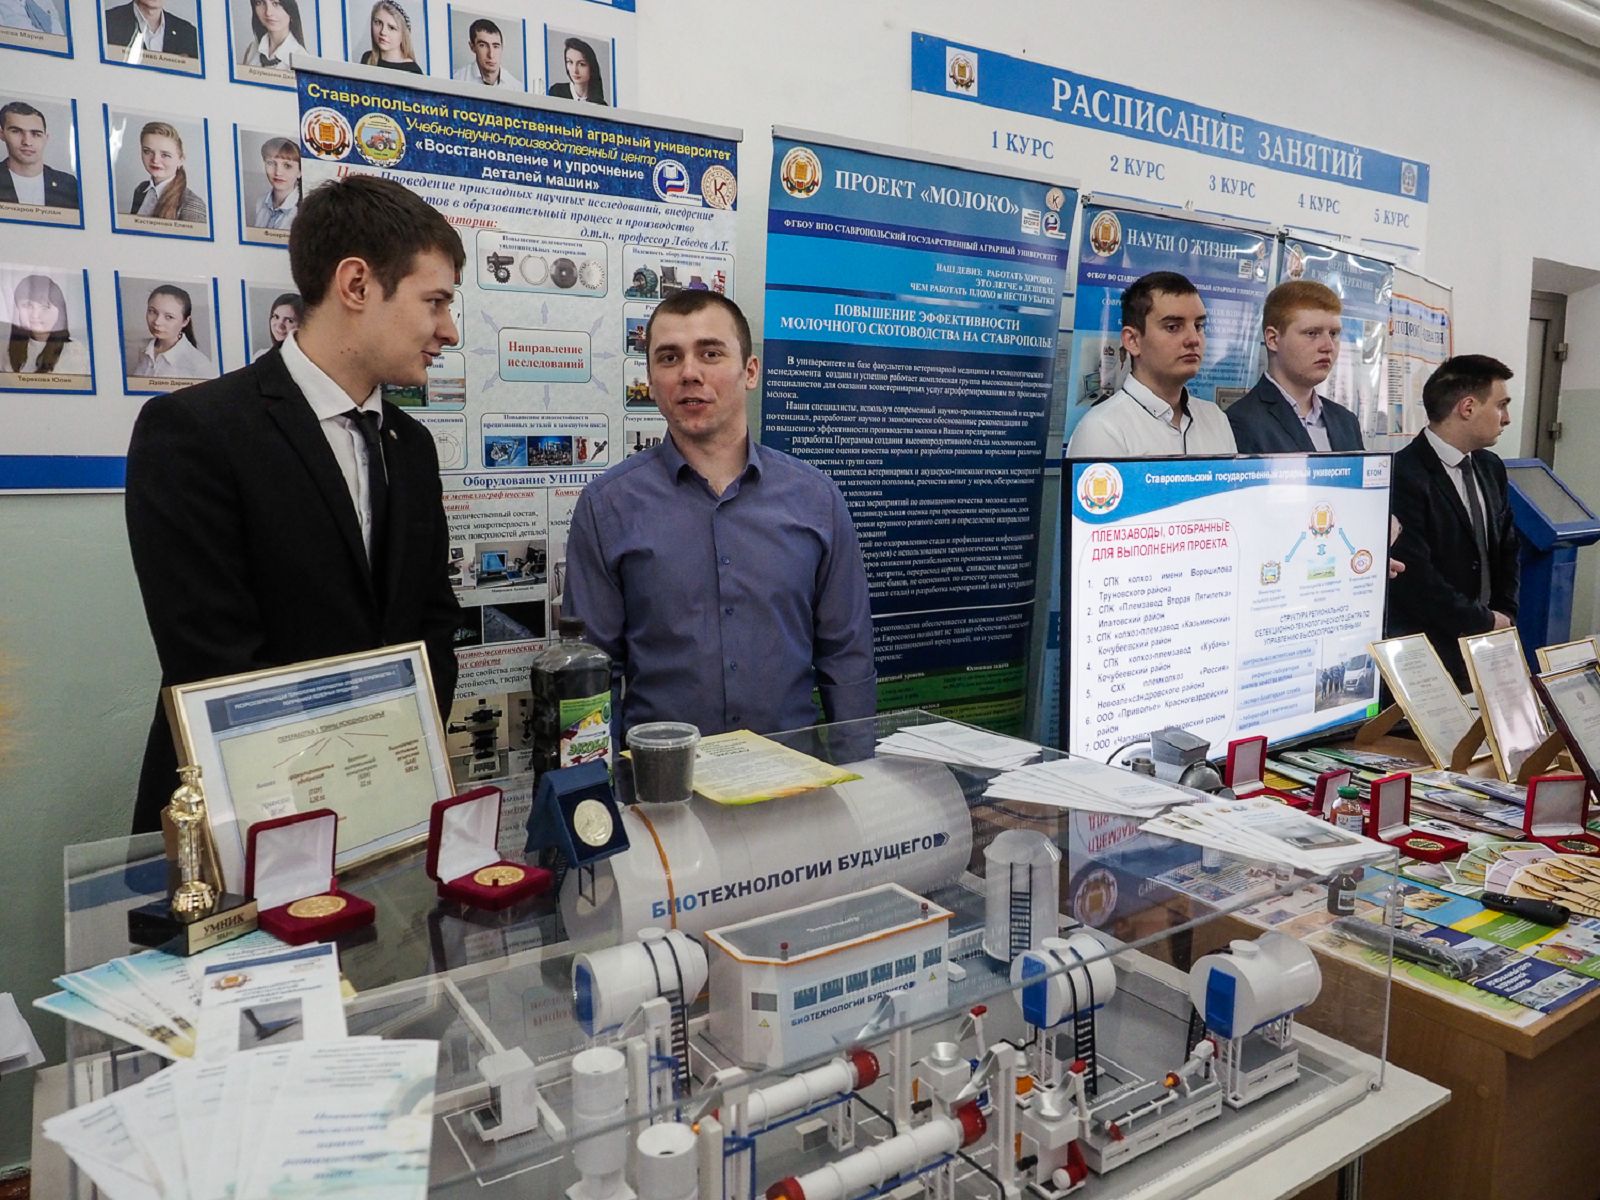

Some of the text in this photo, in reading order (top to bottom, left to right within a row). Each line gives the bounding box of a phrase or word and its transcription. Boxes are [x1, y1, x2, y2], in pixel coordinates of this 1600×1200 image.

[307, 83, 731, 161] Ставропольский государственный аграрный университет
[1052, 77, 1363, 182] РАСПИСАНИЕ ЗАНЯТИЙ
[405, 116, 657, 169] Учебно-научно-производственный центр
[992, 130, 1055, 160] 1 КУРС
[415, 138, 645, 181] «Восстановление и упрочнение
[1110, 155, 1166, 182] 2 КУРС
[481, 167, 600, 191] деталей машин»
[1209, 173, 1256, 200] 3 КУРС
[381, 171, 446, 193] Проведение
[459, 183, 534, 203] прикладных
[536, 191, 586, 207] научных
[588, 198, 662, 218] исследований,
[664, 208, 714, 223] внедрение
[834, 169, 1020, 217] ПРОЕКТ «МОЛОКО»
[1297, 193, 1341, 216] 4 КУРС
[452, 200, 460, 208] в
[463, 198, 567, 223] образовательный
[570, 212, 614, 229] процесс
[615, 217, 624, 226] и
[625, 219, 695, 235] производство
[1373, 209, 1410, 230] 5 КУРС
[618, 234, 729, 253] профессор Лебедев А.Т.
[784, 217, 1058, 263] ФГБОУ ВПО СТАВРОПОЛЬСКИЙ ГОСУДАРСТВЕННЫЙ АГРАРНЫЙ УНИВЕРСИТЕТ
[1127, 228, 1238, 261] НАУКИ О ЖИЗНИ
[936, 263, 1053, 287] НАШ ДЕВИЗ: РАБОТАТЬ ХОРОШО
[975, 278, 1018, 293] ЭТО ЛЕГЧЕ
[910, 282, 1056, 308] ЧЕМ РАБОТАТЬ ПЛОХО НЕСТИ УБЫТКИ
[834, 303, 1020, 334] ПОВЫШЕНИЕ ЭФФЕКТИВНОСТИ
[780, 316, 1054, 351] МОЛОЧНОГО СКОТОВОДСТВА НА СТАВРОПОЛЬЕ
[508, 341, 583, 356] Направление
[507, 358, 584, 371] исследований
[788, 355, 795, 365] В
[796, 358, 847, 371] университете
[857, 360, 871, 369] базе
[872, 360, 913, 374] факультетов
[766, 378, 822, 391] специалистов
[822, 381, 836, 390] для
[837, 382, 868, 392] оказания
[767, 368, 822, 381] менеджмента
[825, 370, 853, 381] создана
[889, 374, 919, 386] работает
[766, 390, 799, 400] молока.
[766, 412, 857, 425] потенциал, разработают
[786, 400, 810, 412] Наши
[811, 401, 860, 414] специалисты,
[765, 424, 815, 434] повышению
[816, 423, 869, 436] эффективности
[792, 435, 834, 446] разработка
[834, 434, 874, 446] Программы
[791, 445, 836, 456] проведение
[463, 475, 546, 491] Оборудование
[1145, 471, 1213, 486] Ставропольский
[1312, 465, 1352, 480] университет
[1091, 520, 1231, 544] ПЛЕМЗАВОДЫ, ОТОБРАННЫЕ
[1092, 537, 1228, 562] ДЛЯ ВЫПОЛНЕНИЯ ПРОЕКТА
[1103, 576, 1120, 587] СПК
[1128, 574, 1153, 583] колхоз
[1161, 571, 1184, 580] имени
[1190, 565, 1233, 577] Ворошилова
[1098, 604, 1115, 615] СПК
[1118, 600, 1163, 613] «Племзавод
[1166, 595, 1191, 605] Вторая
[1194, 590, 1232, 602] Пятилетка»
[1099, 585, 1172, 603] Труновского района
[1096, 632, 1112, 643] СПК
[1114, 622, 1180, 640] колхоз-племзавод
[1098, 616, 1142, 629] Ипатовский
[1150, 637, 1172, 649] район
[1103, 658, 1119, 669] СПК
[1128, 646, 1192, 664] колхоз-племзавод
[1150, 663, 1171, 675] район
[1110, 664, 1229, 693] СХК «Россия»
[1097, 681, 1205, 710] Новоалександровского района
[1096, 714, 1115, 724] ООО
[1117, 704, 1162, 720] «Приволье»
[1093, 739, 1112, 751] ООО
[1204, 713, 1226, 726] район
[1096, 726, 1119, 738] район
[651, 834, 934, 919] БИОТЕХНОЛОГИИ БУДУЩЕГО
[203, 912, 245, 937] УМНИК
[790, 995, 866, 1027] БИОТЕХНОЛОГИИ
